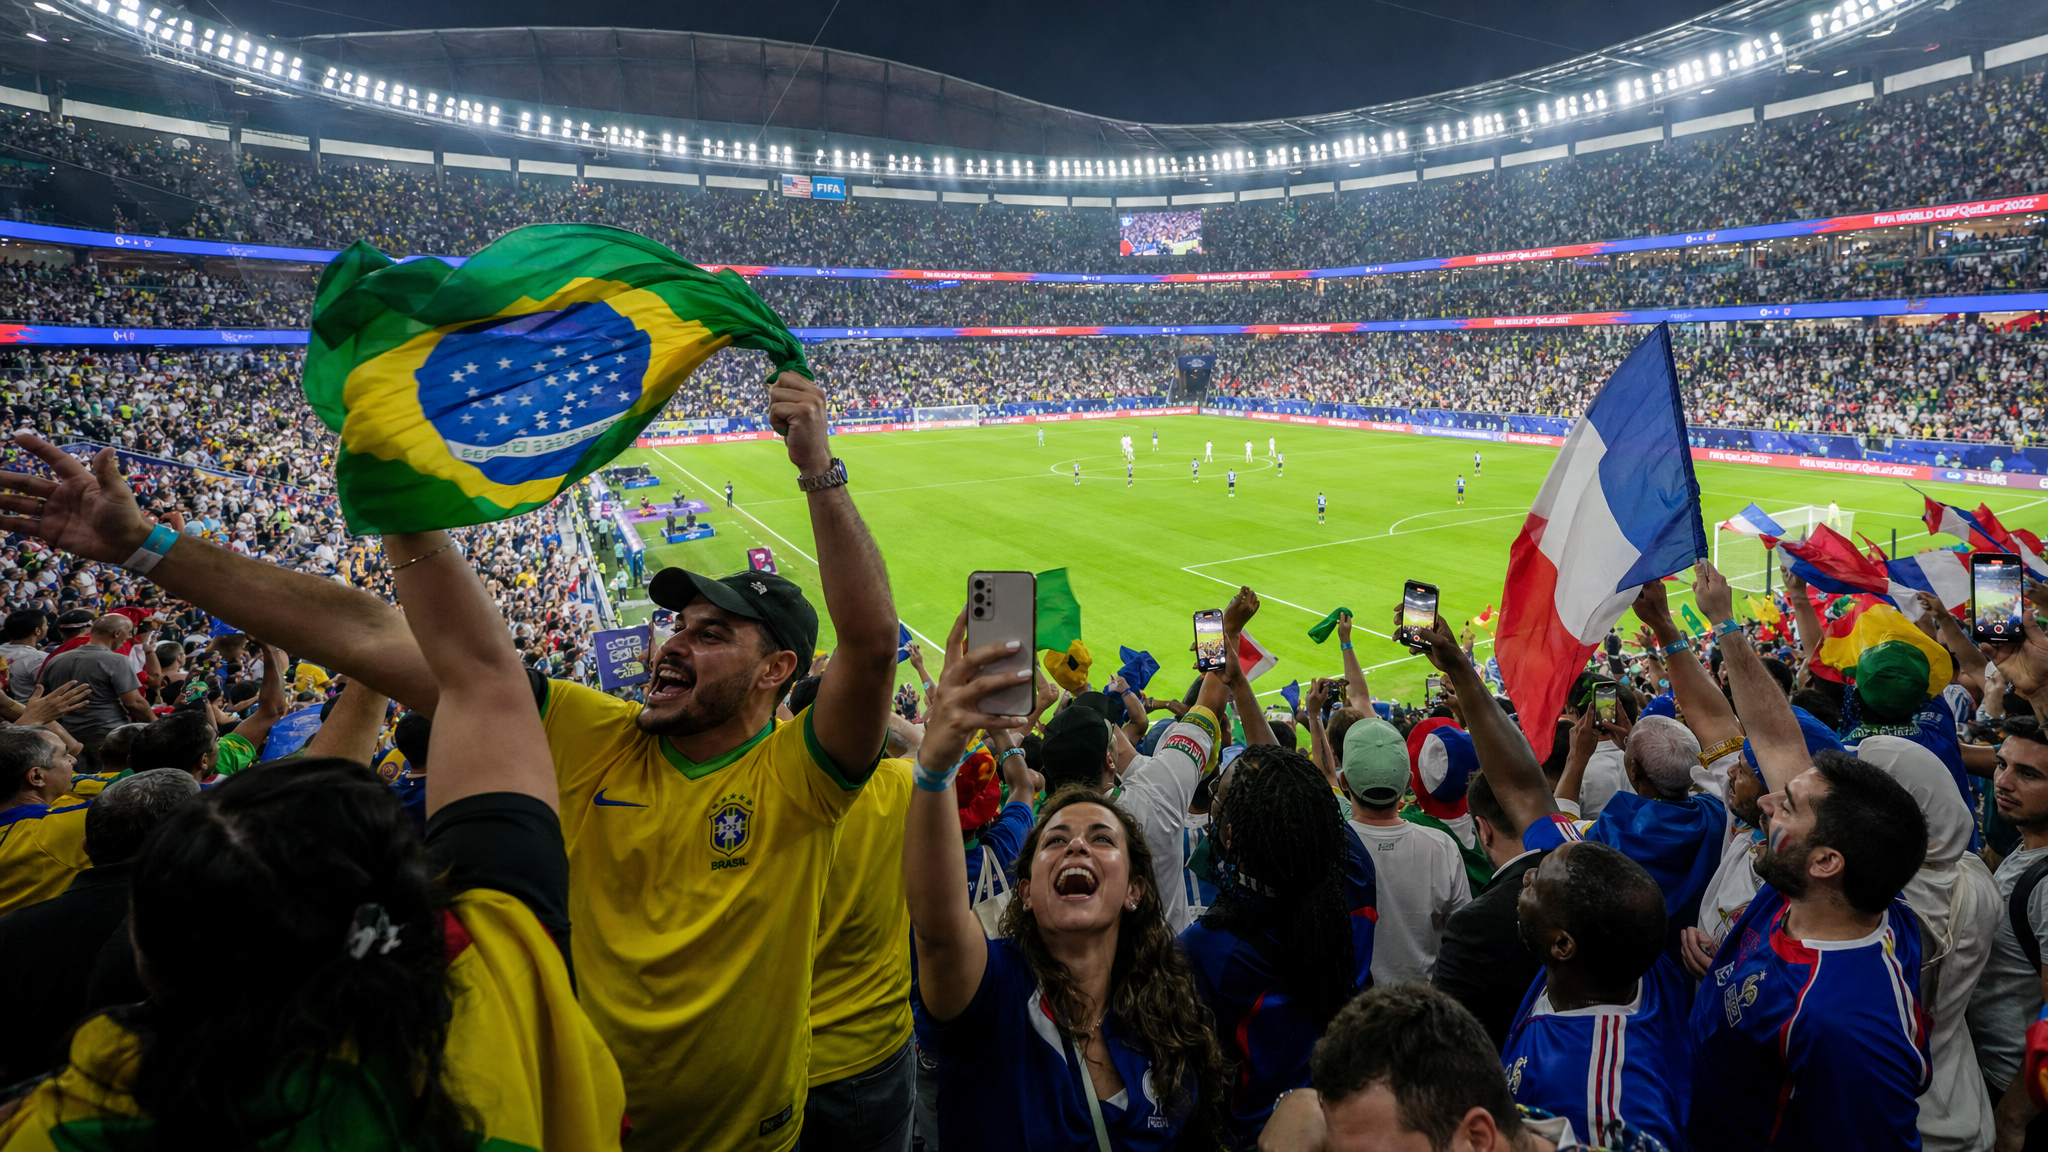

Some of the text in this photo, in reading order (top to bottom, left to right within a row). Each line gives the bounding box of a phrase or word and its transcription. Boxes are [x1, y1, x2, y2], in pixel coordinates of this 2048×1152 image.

[817, 183, 841, 194] FIFA
[1896, 210, 1934, 222] WORLD
[711, 857, 749, 871] BRASIL
